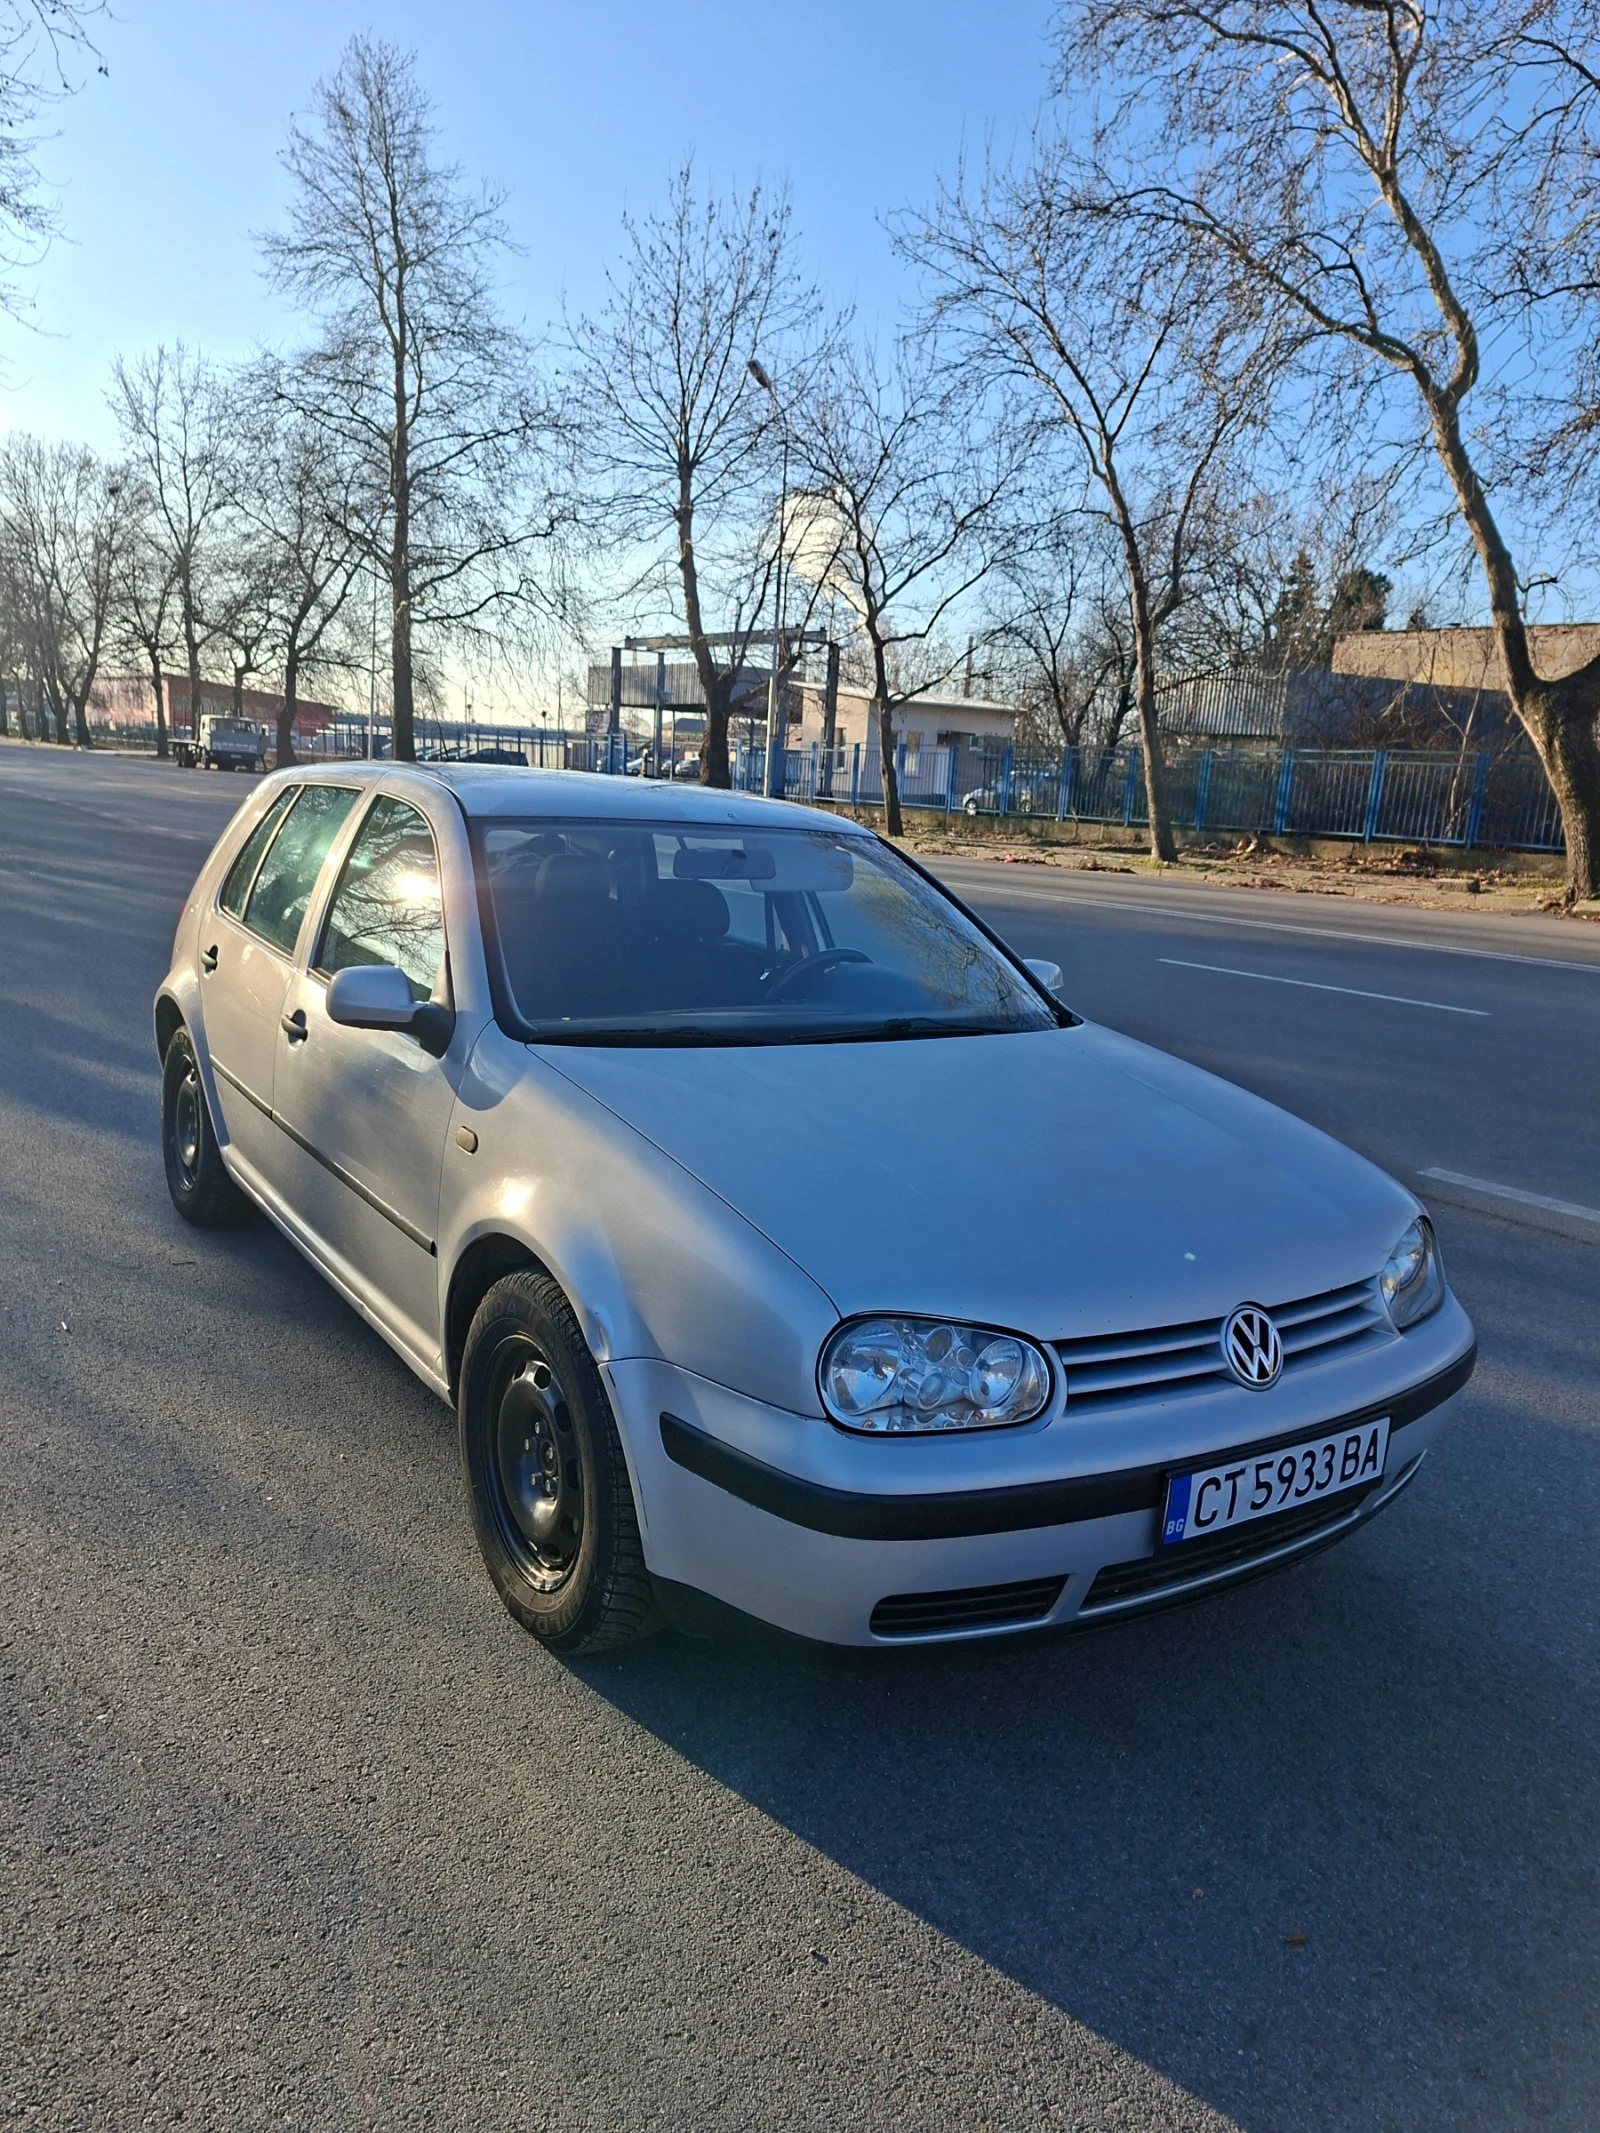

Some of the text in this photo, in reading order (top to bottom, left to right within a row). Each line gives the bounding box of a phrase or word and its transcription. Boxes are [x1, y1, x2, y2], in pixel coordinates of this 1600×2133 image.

[1230, 1311, 1280, 1381] VW
[1166, 1518, 1184, 1536] BG
[521, 1592, 582, 1635] FULDA
